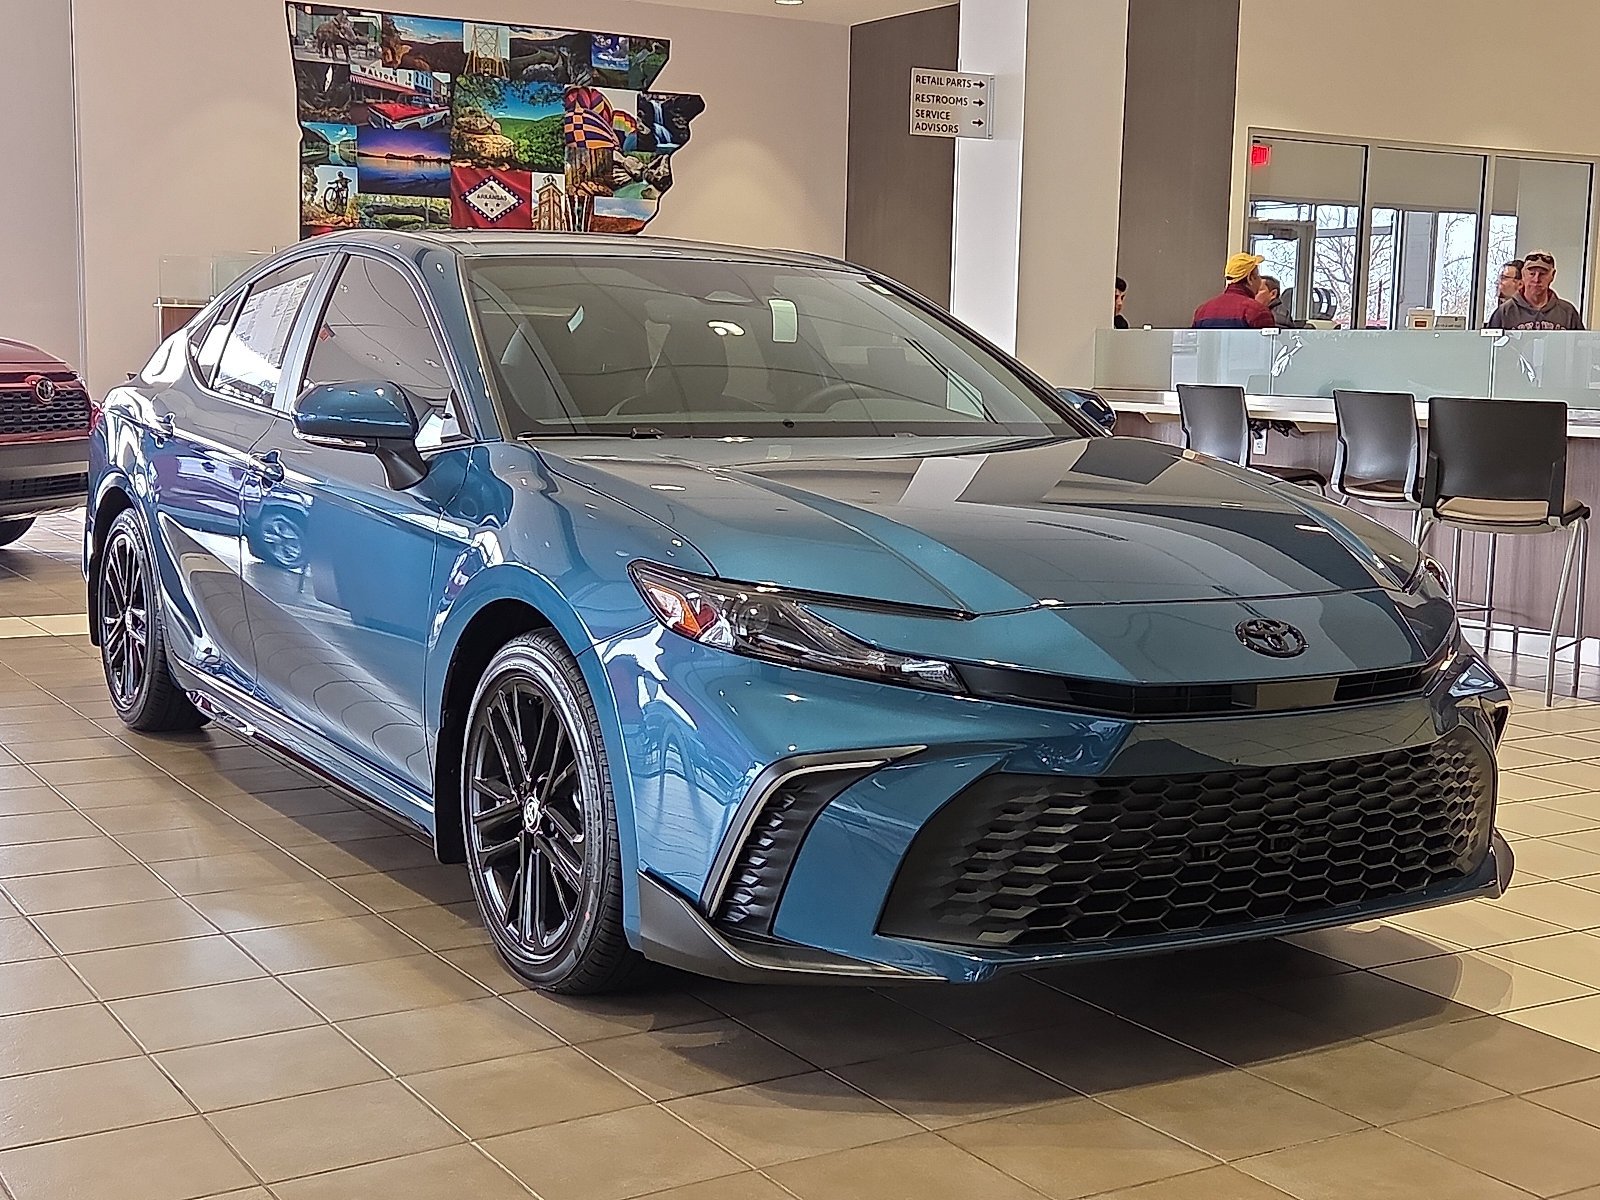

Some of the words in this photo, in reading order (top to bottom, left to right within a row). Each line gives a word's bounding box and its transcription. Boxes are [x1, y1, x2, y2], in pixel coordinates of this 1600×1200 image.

[915, 74, 944, 86] RETAIL
[946, 77, 972, 88] PARTS
[915, 93, 968, 106] RESTROOMS
[915, 109, 951, 120] SERVICE
[915, 122, 959, 133] ADVISORS
